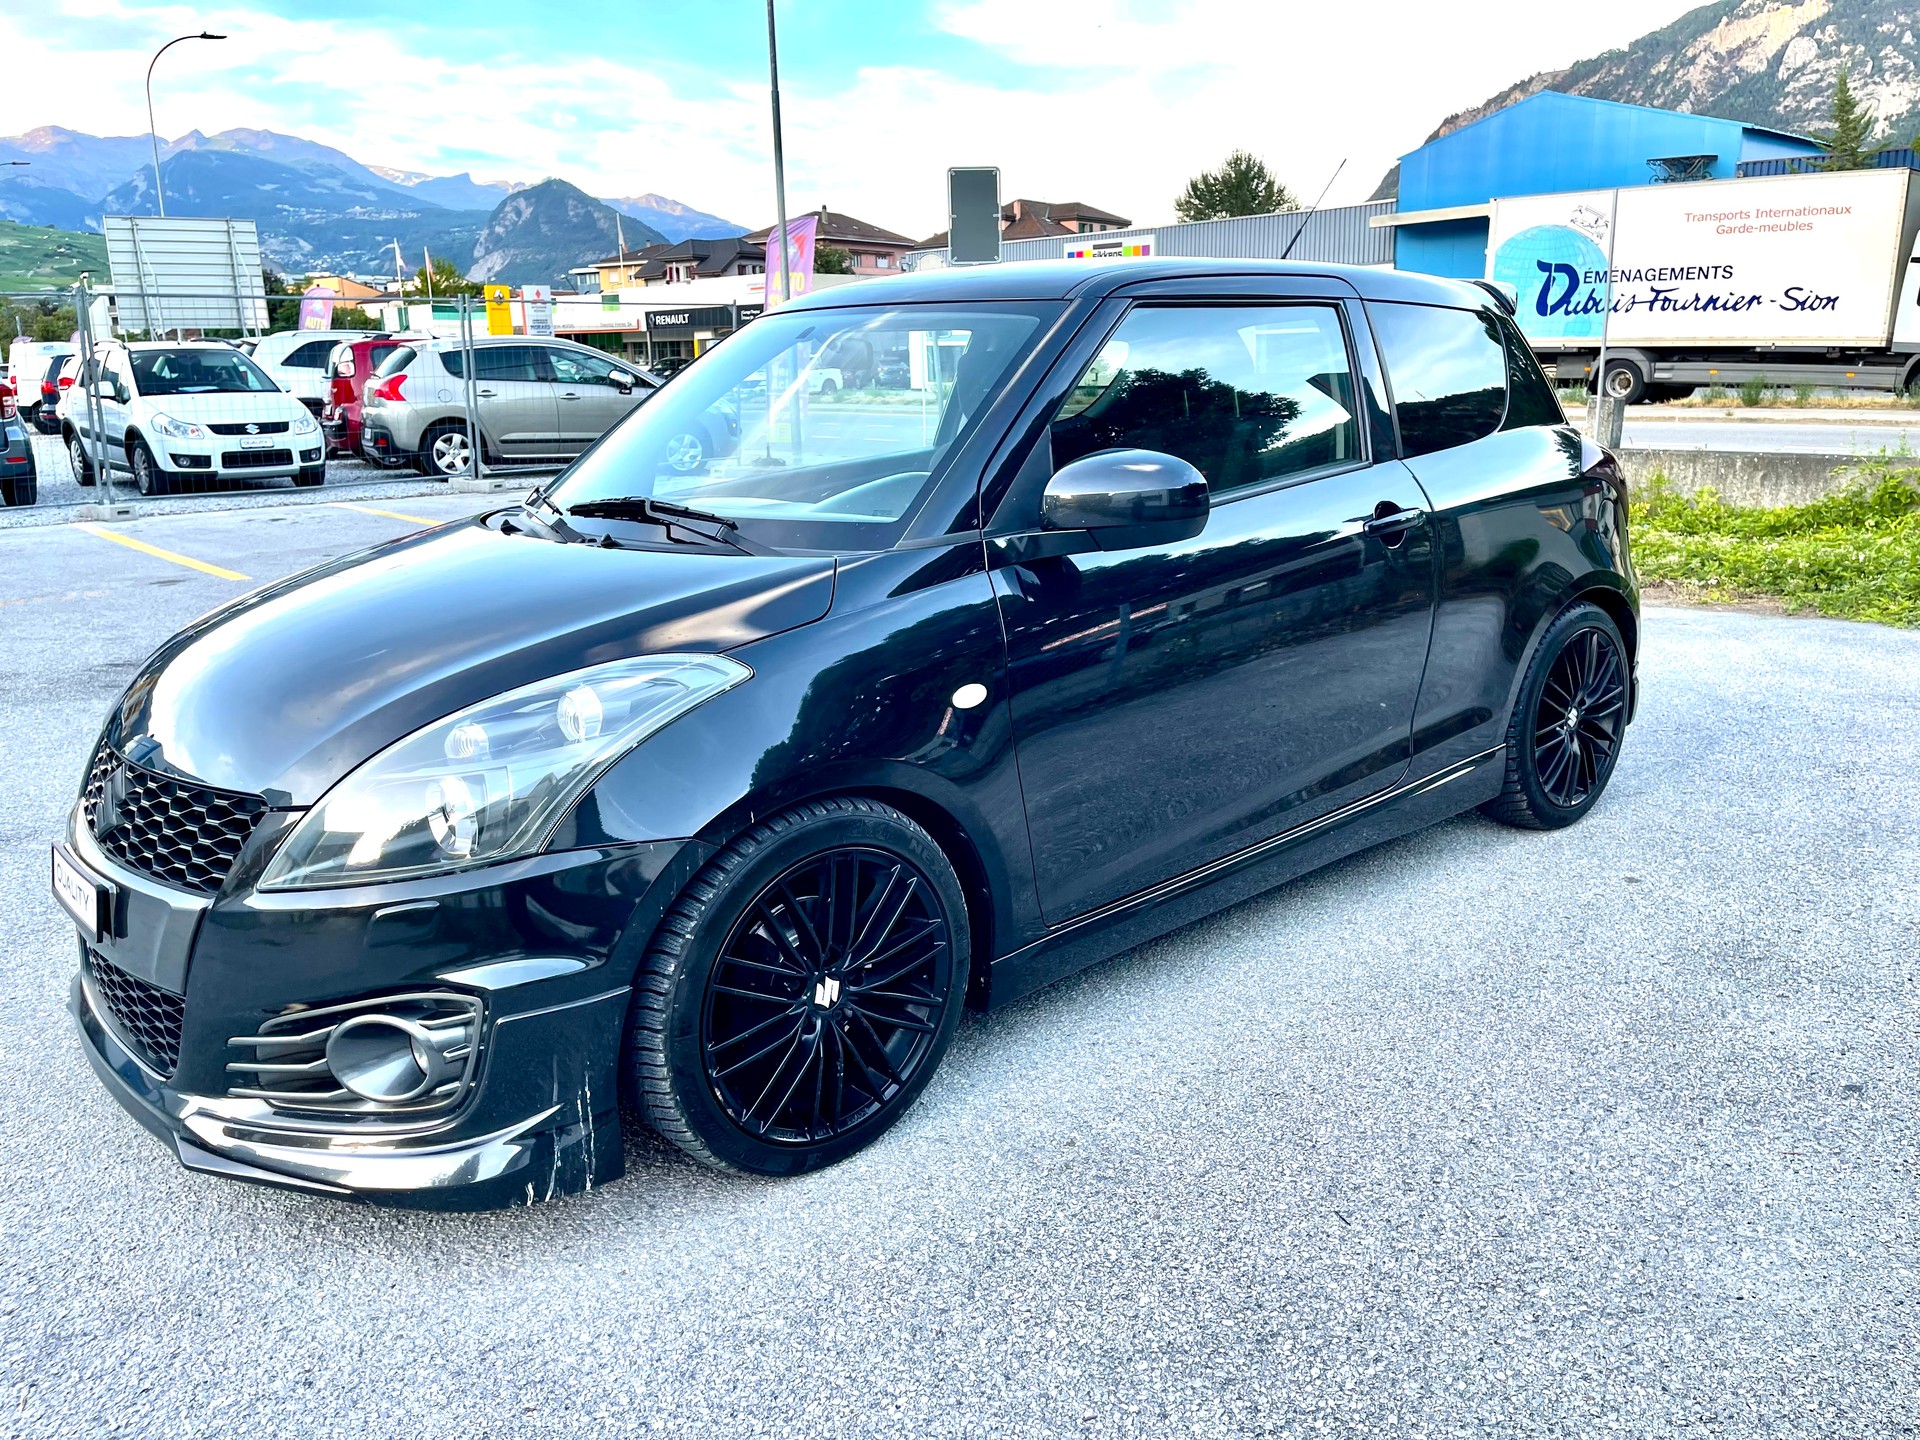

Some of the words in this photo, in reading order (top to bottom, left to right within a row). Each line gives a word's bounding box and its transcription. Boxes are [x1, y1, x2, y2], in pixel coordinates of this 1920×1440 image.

[1684, 210, 1751, 223] Transports
[1755, 206, 1852, 219] Internationaux
[1716, 221, 1814, 235] Garde-meubles
[772, 271, 805, 292] ATO
[1779, 287, 1840, 312] Sion
[305, 316, 327, 330] AUTO
[655, 313, 690, 325] RENAULT
[57, 863, 90, 911] QUALITY
